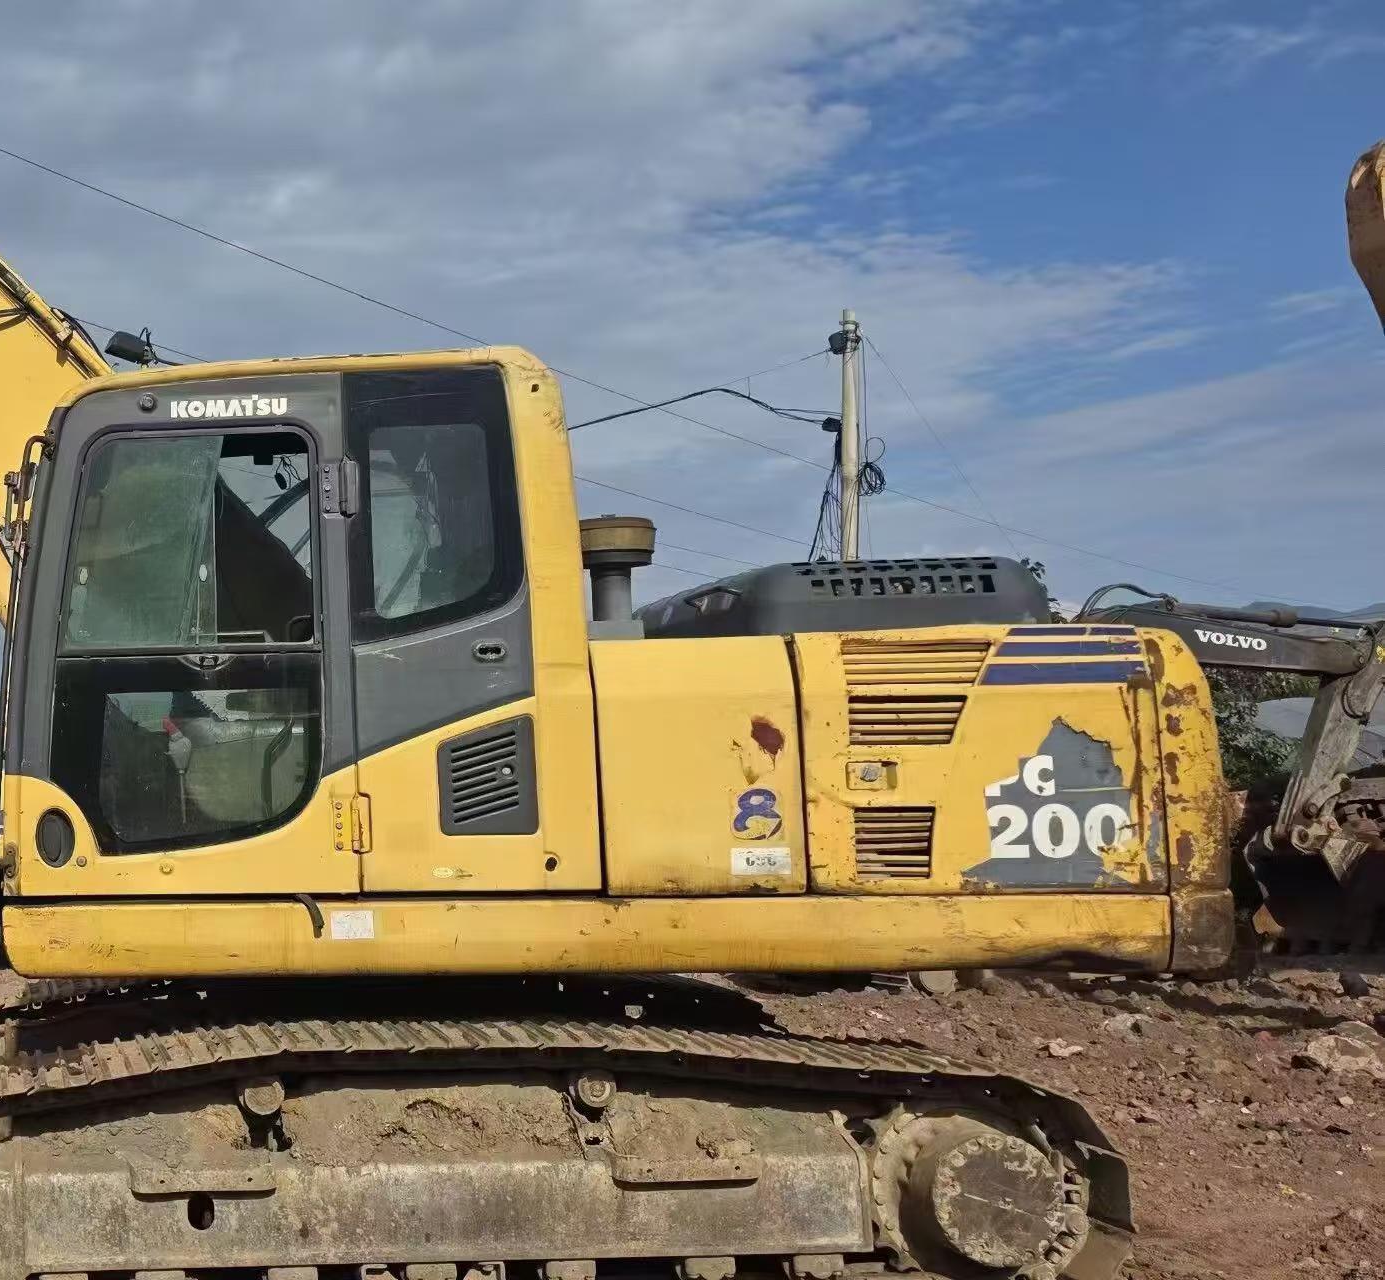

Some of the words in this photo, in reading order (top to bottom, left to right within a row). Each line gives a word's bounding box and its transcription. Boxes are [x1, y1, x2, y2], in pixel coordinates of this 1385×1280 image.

[170, 394, 288, 418] KOMATSU
[1194, 629, 1267, 651] VOLVO
[733, 788, 783, 841] 8
[986, 803, 1133, 859] 200
